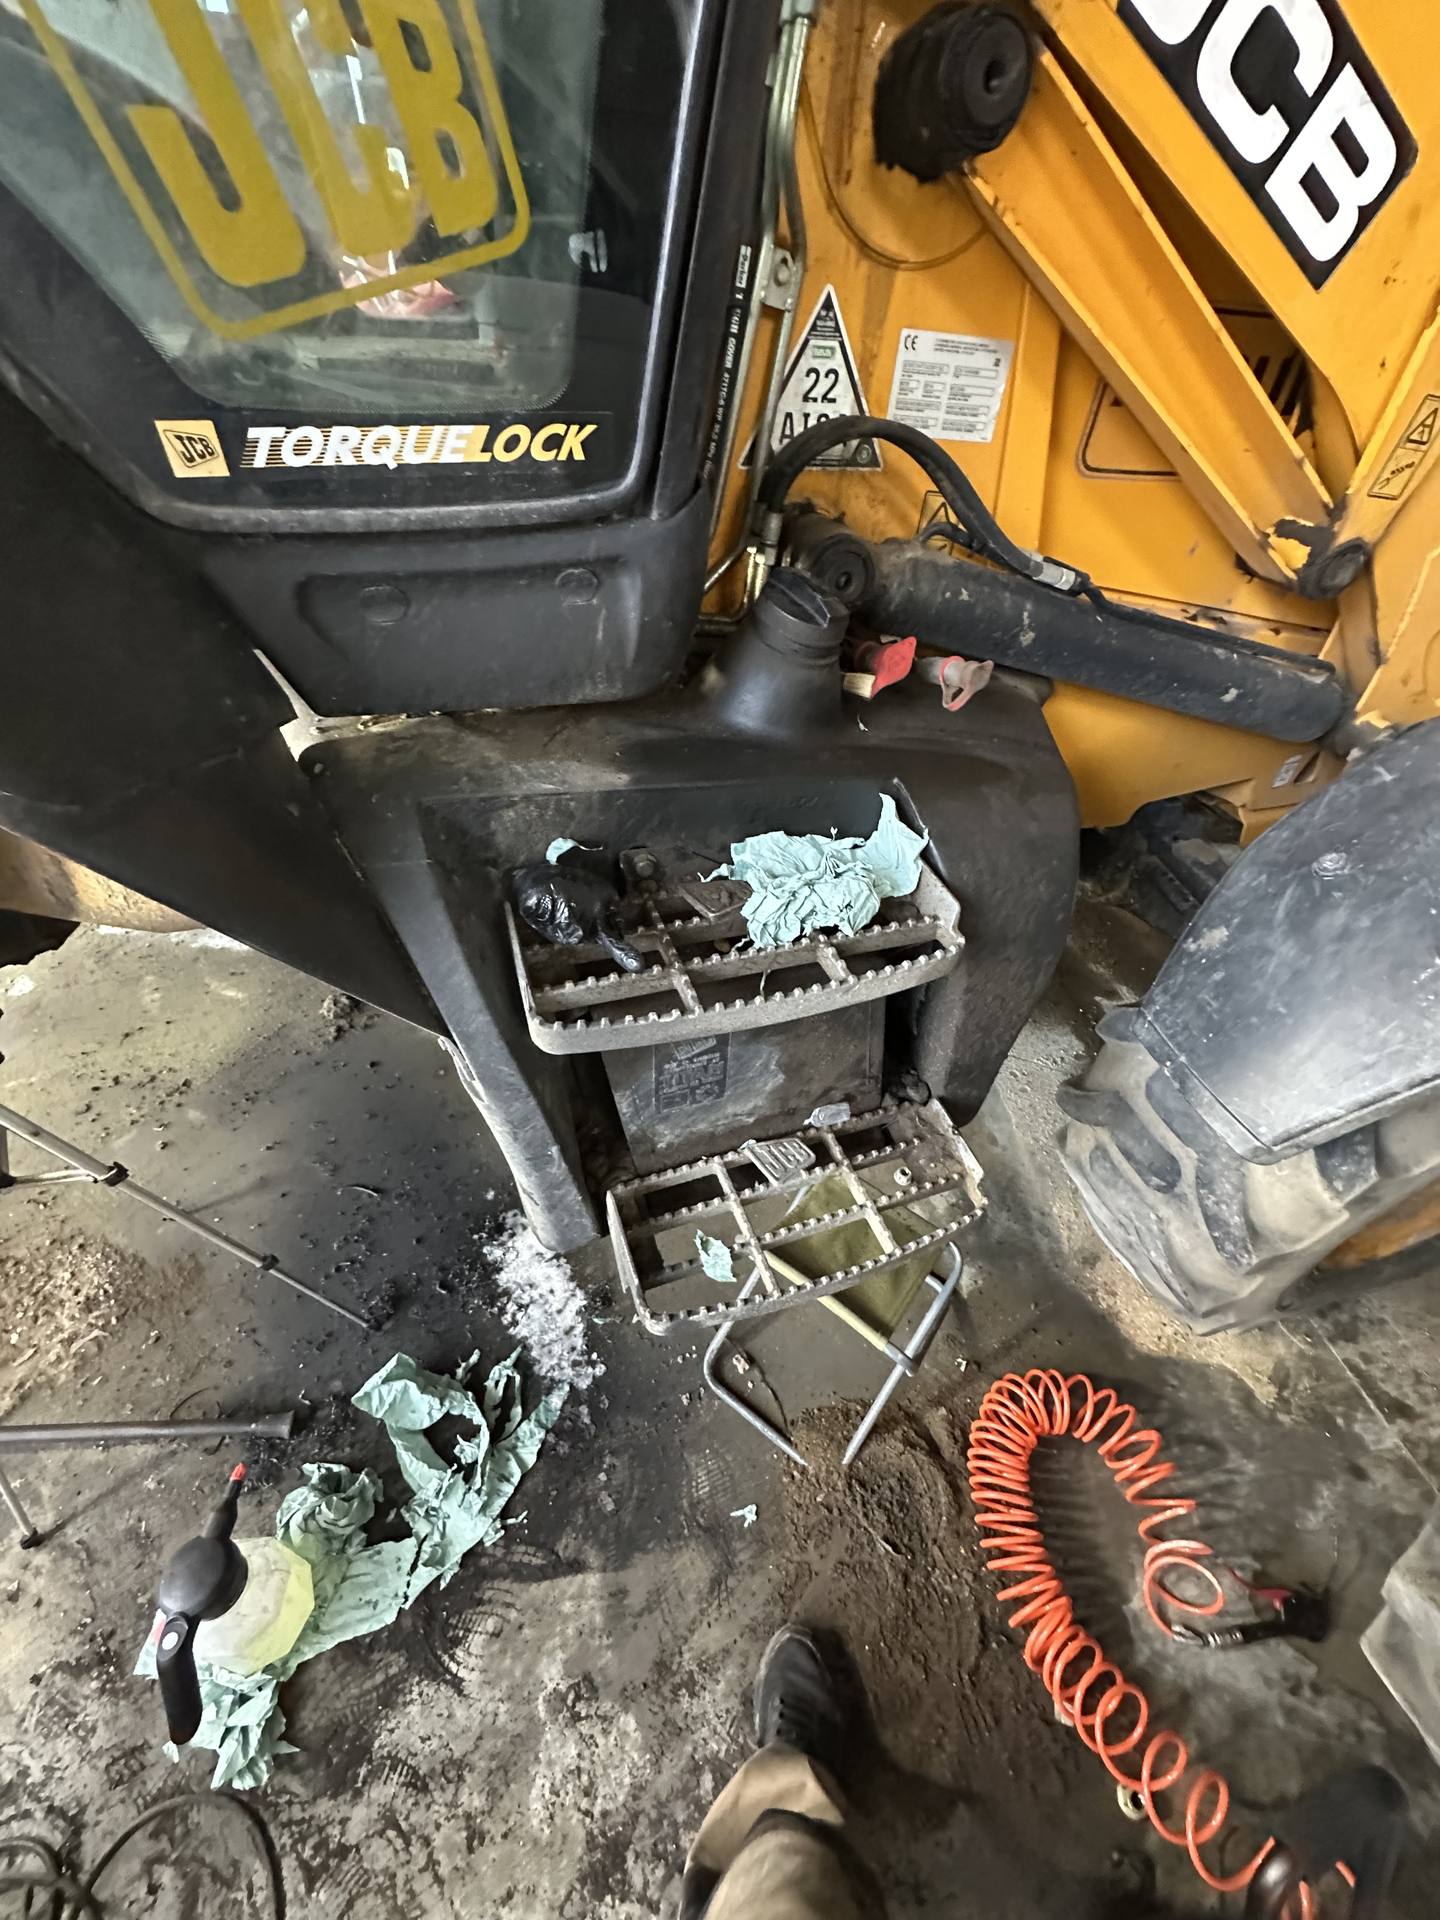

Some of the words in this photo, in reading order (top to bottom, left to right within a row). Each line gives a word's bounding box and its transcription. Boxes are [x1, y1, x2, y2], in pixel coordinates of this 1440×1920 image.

[1130, 0, 1397, 262] CB
[737, 249, 751, 287] Parker
[725, 337, 736, 368] COVER
[904, 334, 919, 351] CE
[802, 367, 839, 403] 22
[173, 434, 216, 464] JCB
[242, 424, 598, 470] TORQUELOCK
[754, 1140, 810, 1180] JCB
